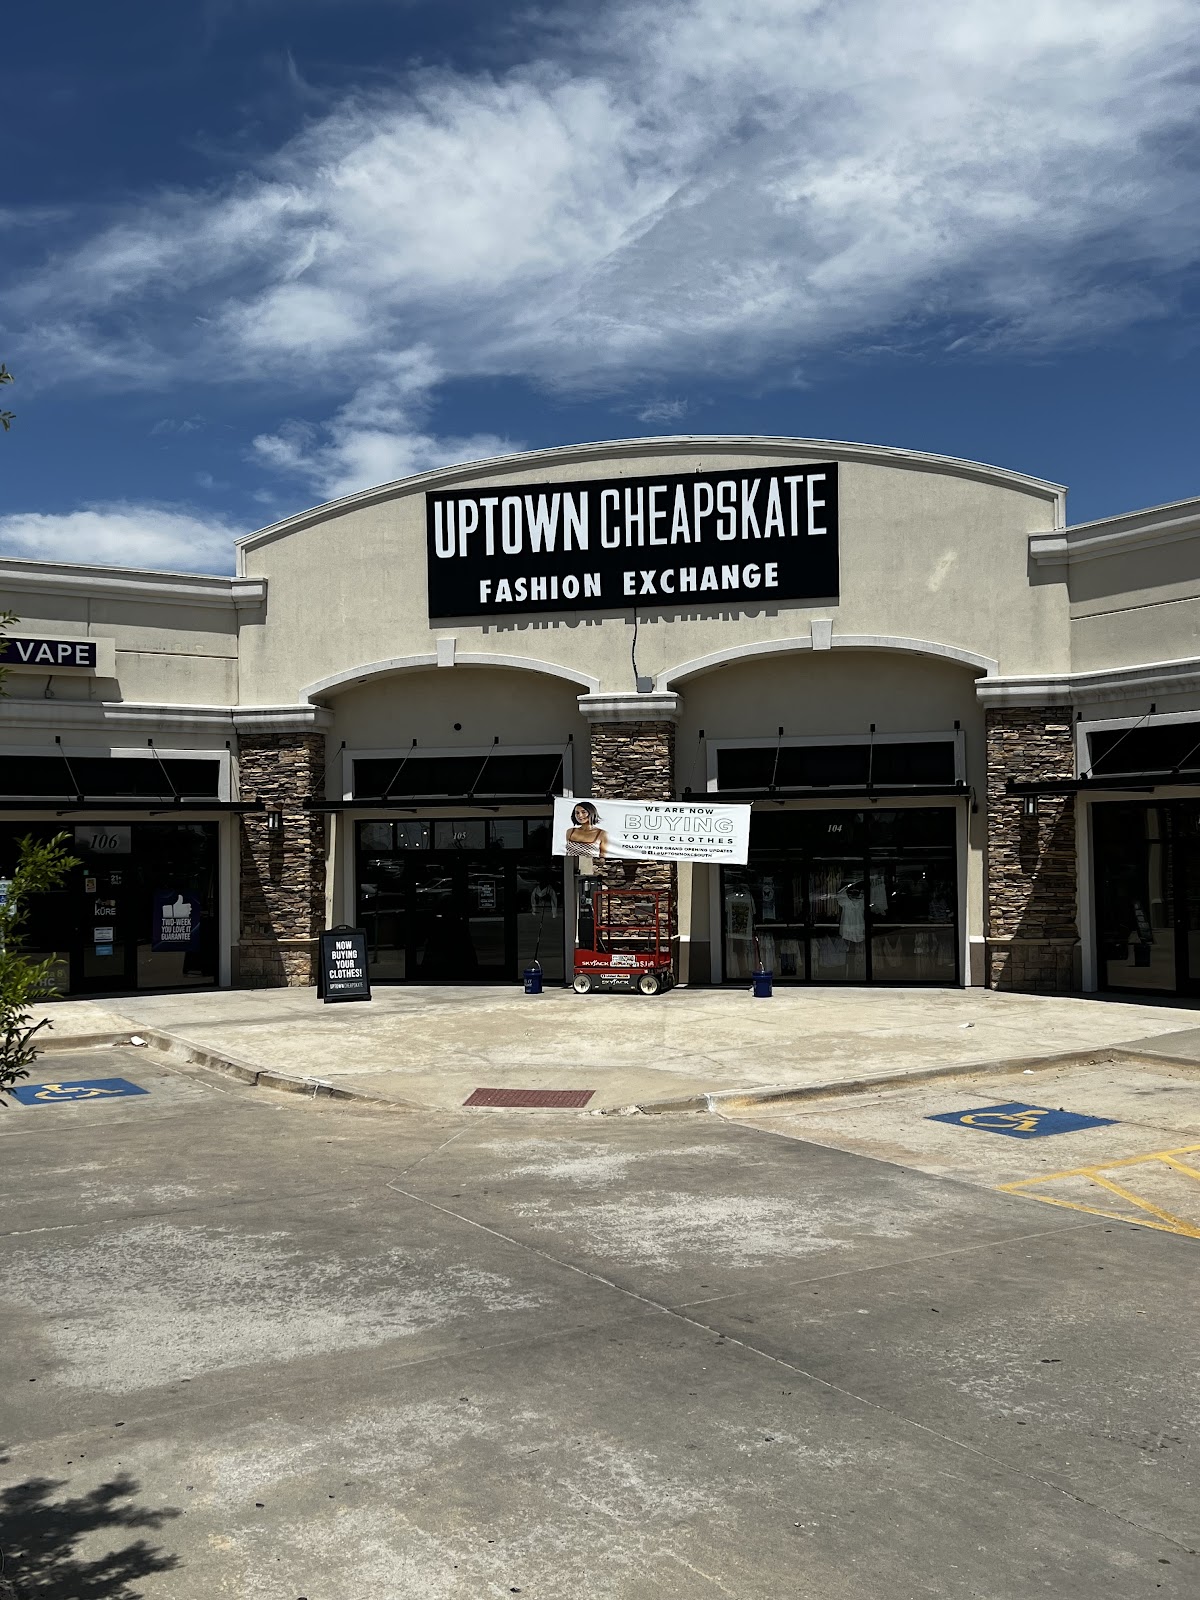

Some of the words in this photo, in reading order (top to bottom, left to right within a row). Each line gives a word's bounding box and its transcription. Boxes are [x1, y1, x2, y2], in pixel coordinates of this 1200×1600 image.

[434, 490, 588, 558] UPTOWN
[601, 473, 828, 549] CHEAPSKATE
[479, 572, 602, 603] FASHION
[623, 562, 779, 596] EXCHANGE
[15, 641, 90, 665] VAPE
[624, 814, 734, 833] BUYING
[827, 824, 843, 833] 104
[90, 833, 118, 849] 106
[453, 831, 467, 840] 105
[623, 833, 659, 841] YOUR
[669, 835, 734, 844] CLOTHES
[161, 918, 192, 926] TWO-WEEK
[336, 941, 352, 950] NOW
[331, 950, 358, 959] BUYING
[335, 960, 355, 968] YOUR
[329, 968, 363, 979] CLOTHES!
